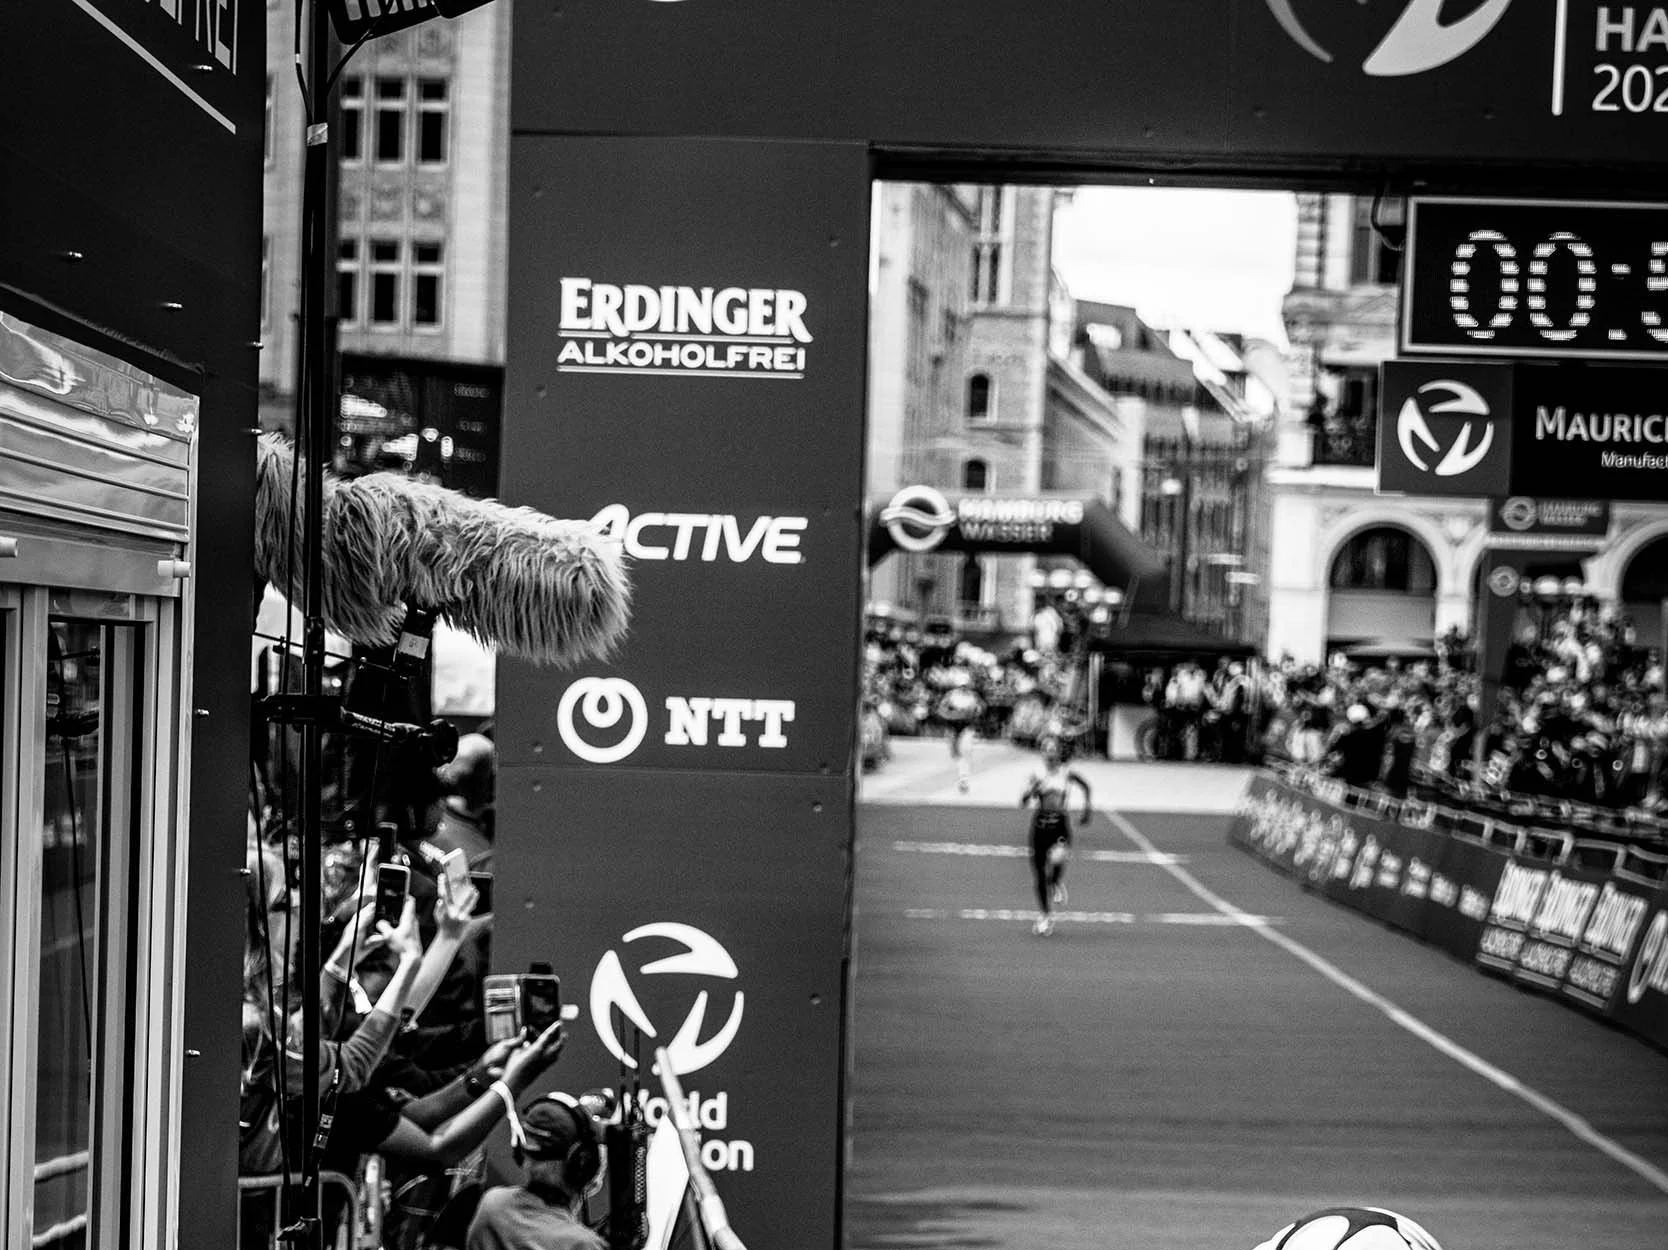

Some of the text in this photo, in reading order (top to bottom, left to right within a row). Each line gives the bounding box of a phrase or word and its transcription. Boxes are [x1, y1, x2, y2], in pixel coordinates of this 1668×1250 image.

[1595, 6, 1668, 52] HA
[559, 277, 814, 343] ERDINGER
[557, 340, 806, 371] ALKOHOLFREI
[1535, 405, 1668, 443] MAURIC
[664, 697, 795, 748] NTT
